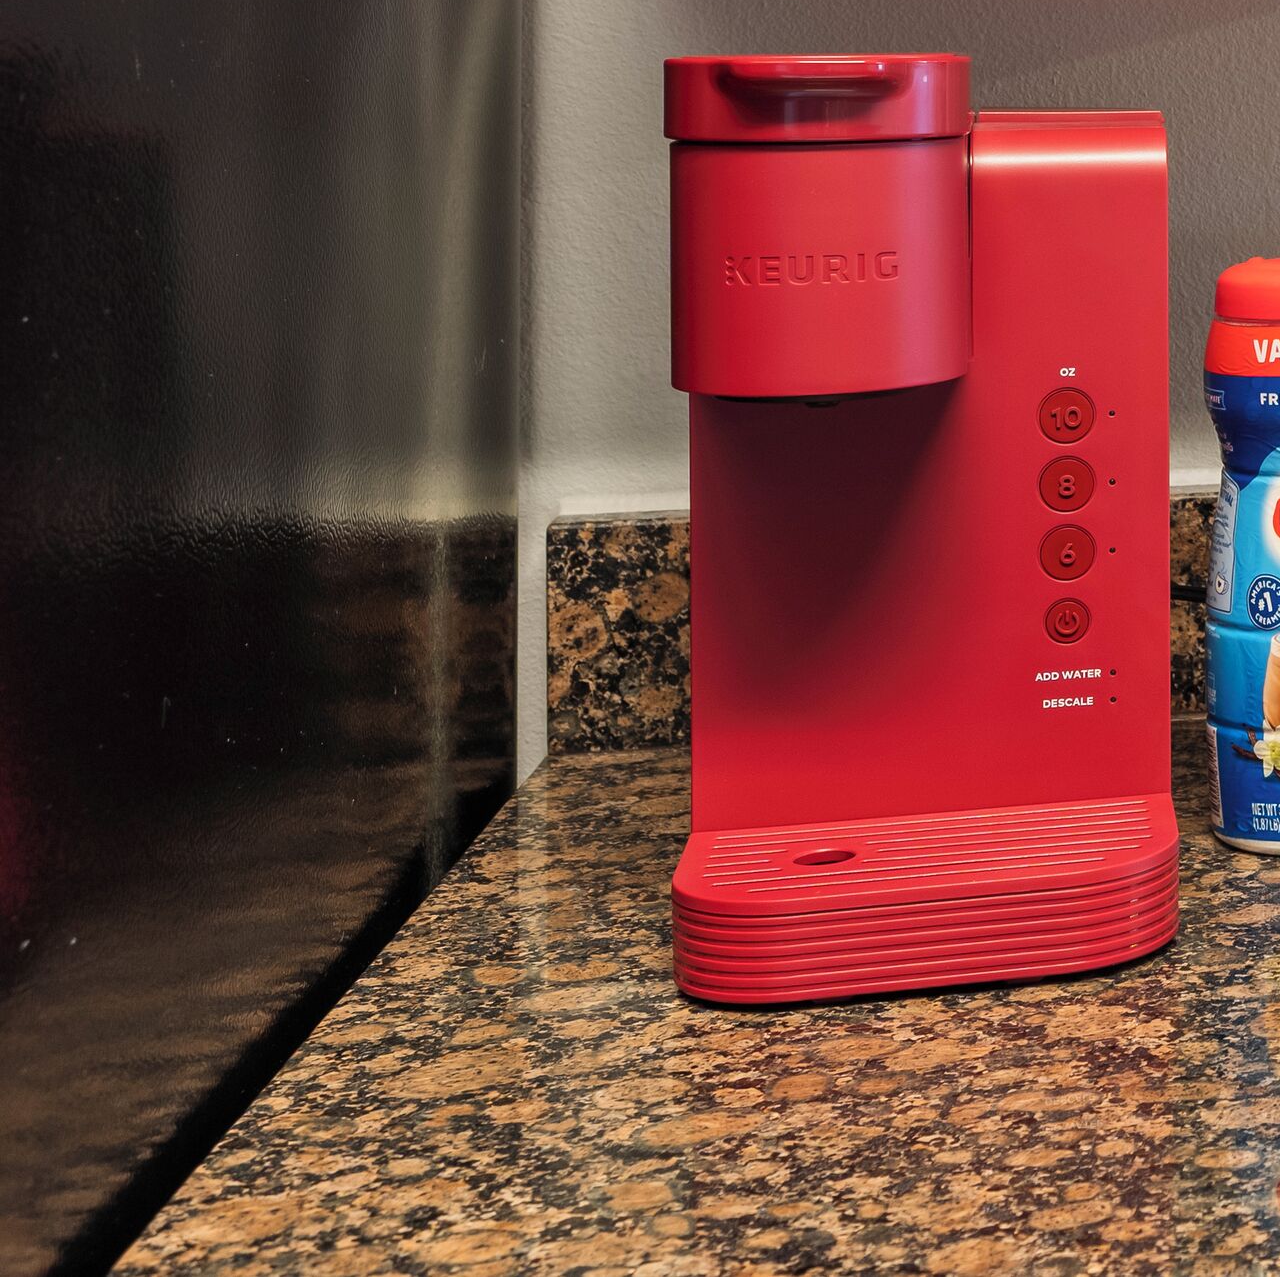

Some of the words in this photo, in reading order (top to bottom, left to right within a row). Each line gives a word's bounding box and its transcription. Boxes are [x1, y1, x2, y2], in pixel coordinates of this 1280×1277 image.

[725, 251, 898, 286] KEURIG
[1060, 368, 1075, 377] OZ
[1050, 406, 1082, 428] 10
[1057, 474, 1076, 497] 8
[1060, 542, 1077, 565] 6
[1258, 592, 1273, 613] #1
[1035, 670, 1060, 682] ADD
[1061, 668, 1102, 680] WATER
[1042, 696, 1094, 709] DESCALE
[1252, 803, 1265, 815] NET
[1266, 803, 1277, 816] WT
[1270, 818, 1280, 833] LB)
